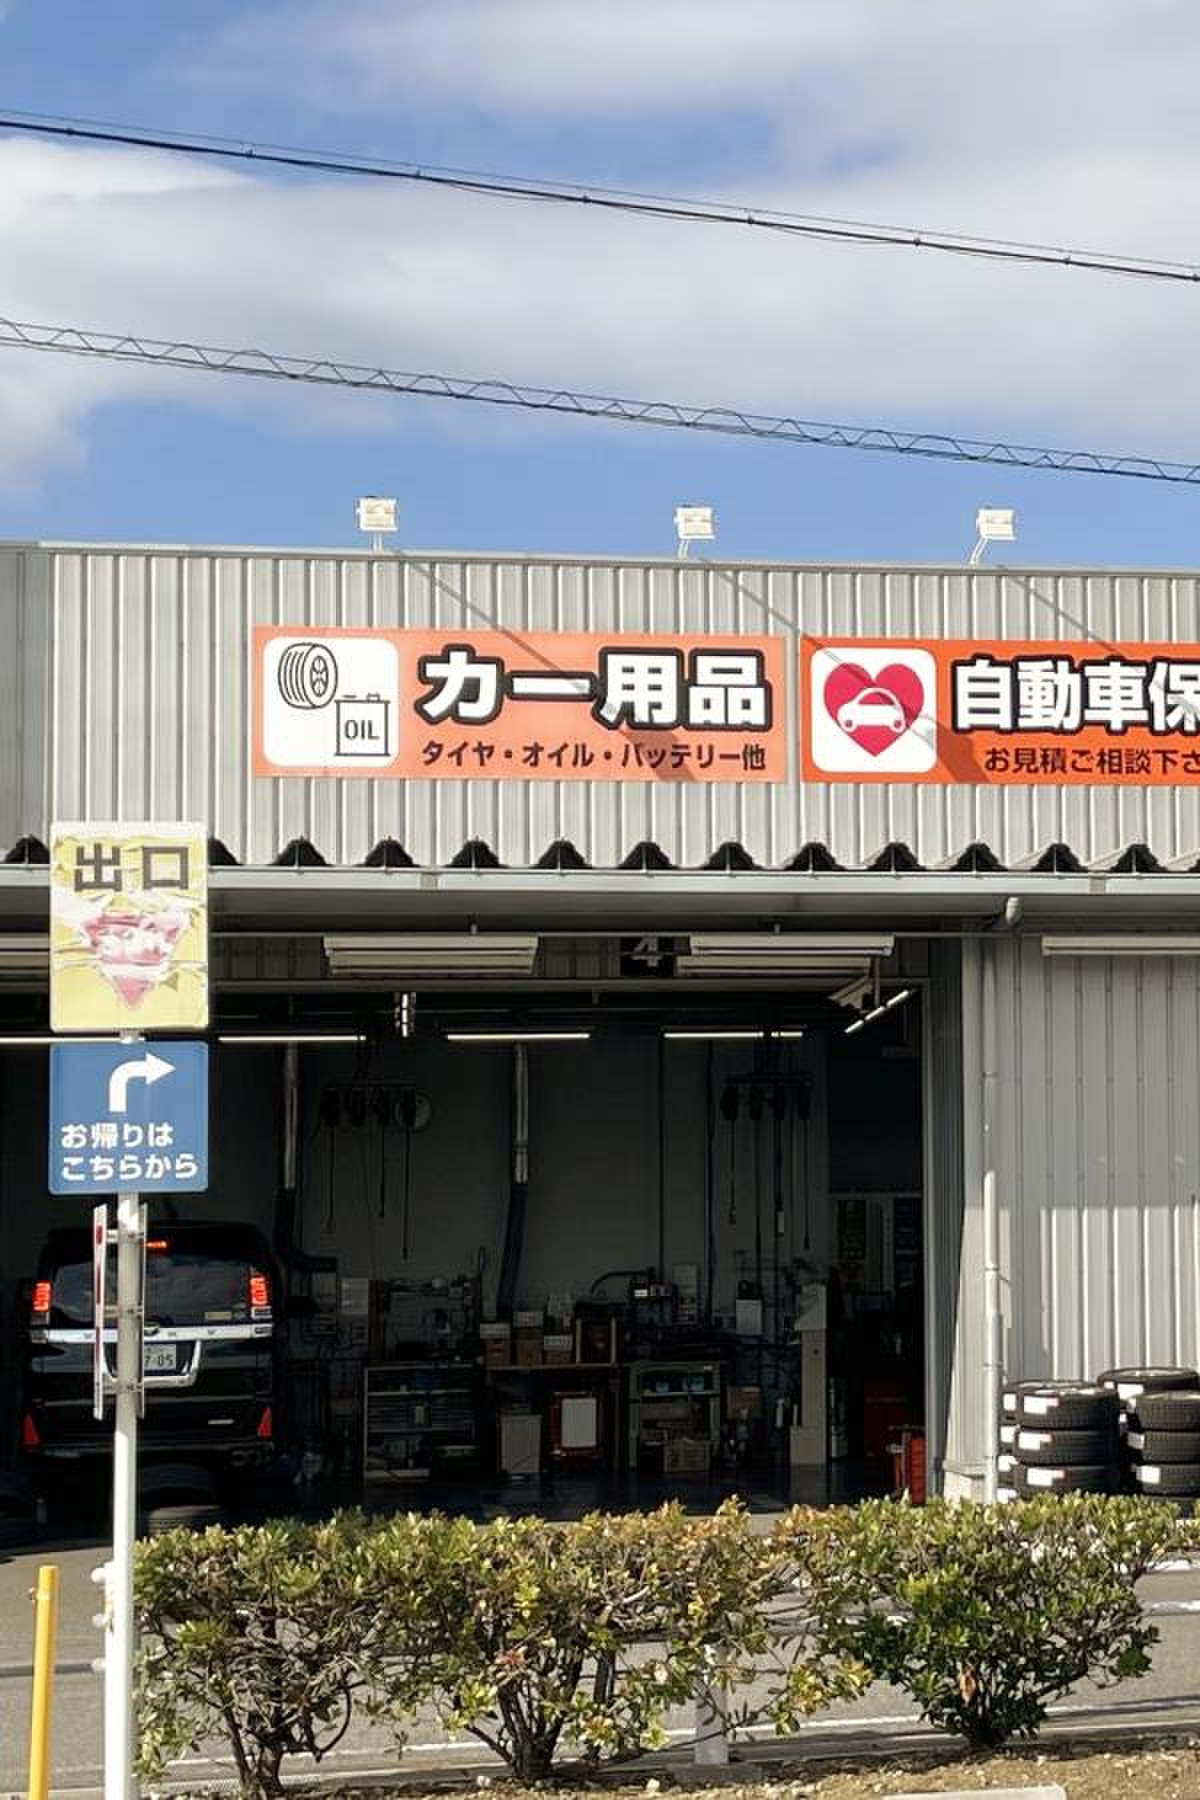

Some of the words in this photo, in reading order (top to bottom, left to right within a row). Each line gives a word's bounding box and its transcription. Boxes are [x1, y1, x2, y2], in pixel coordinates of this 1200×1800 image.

[417, 644, 773, 731] カー用品
[344, 718, 379, 741] OIL
[74, 842, 190, 892] 出口
[61, 1122, 174, 1149] お帰りは
[61, 1152, 198, 1181] こちらから
